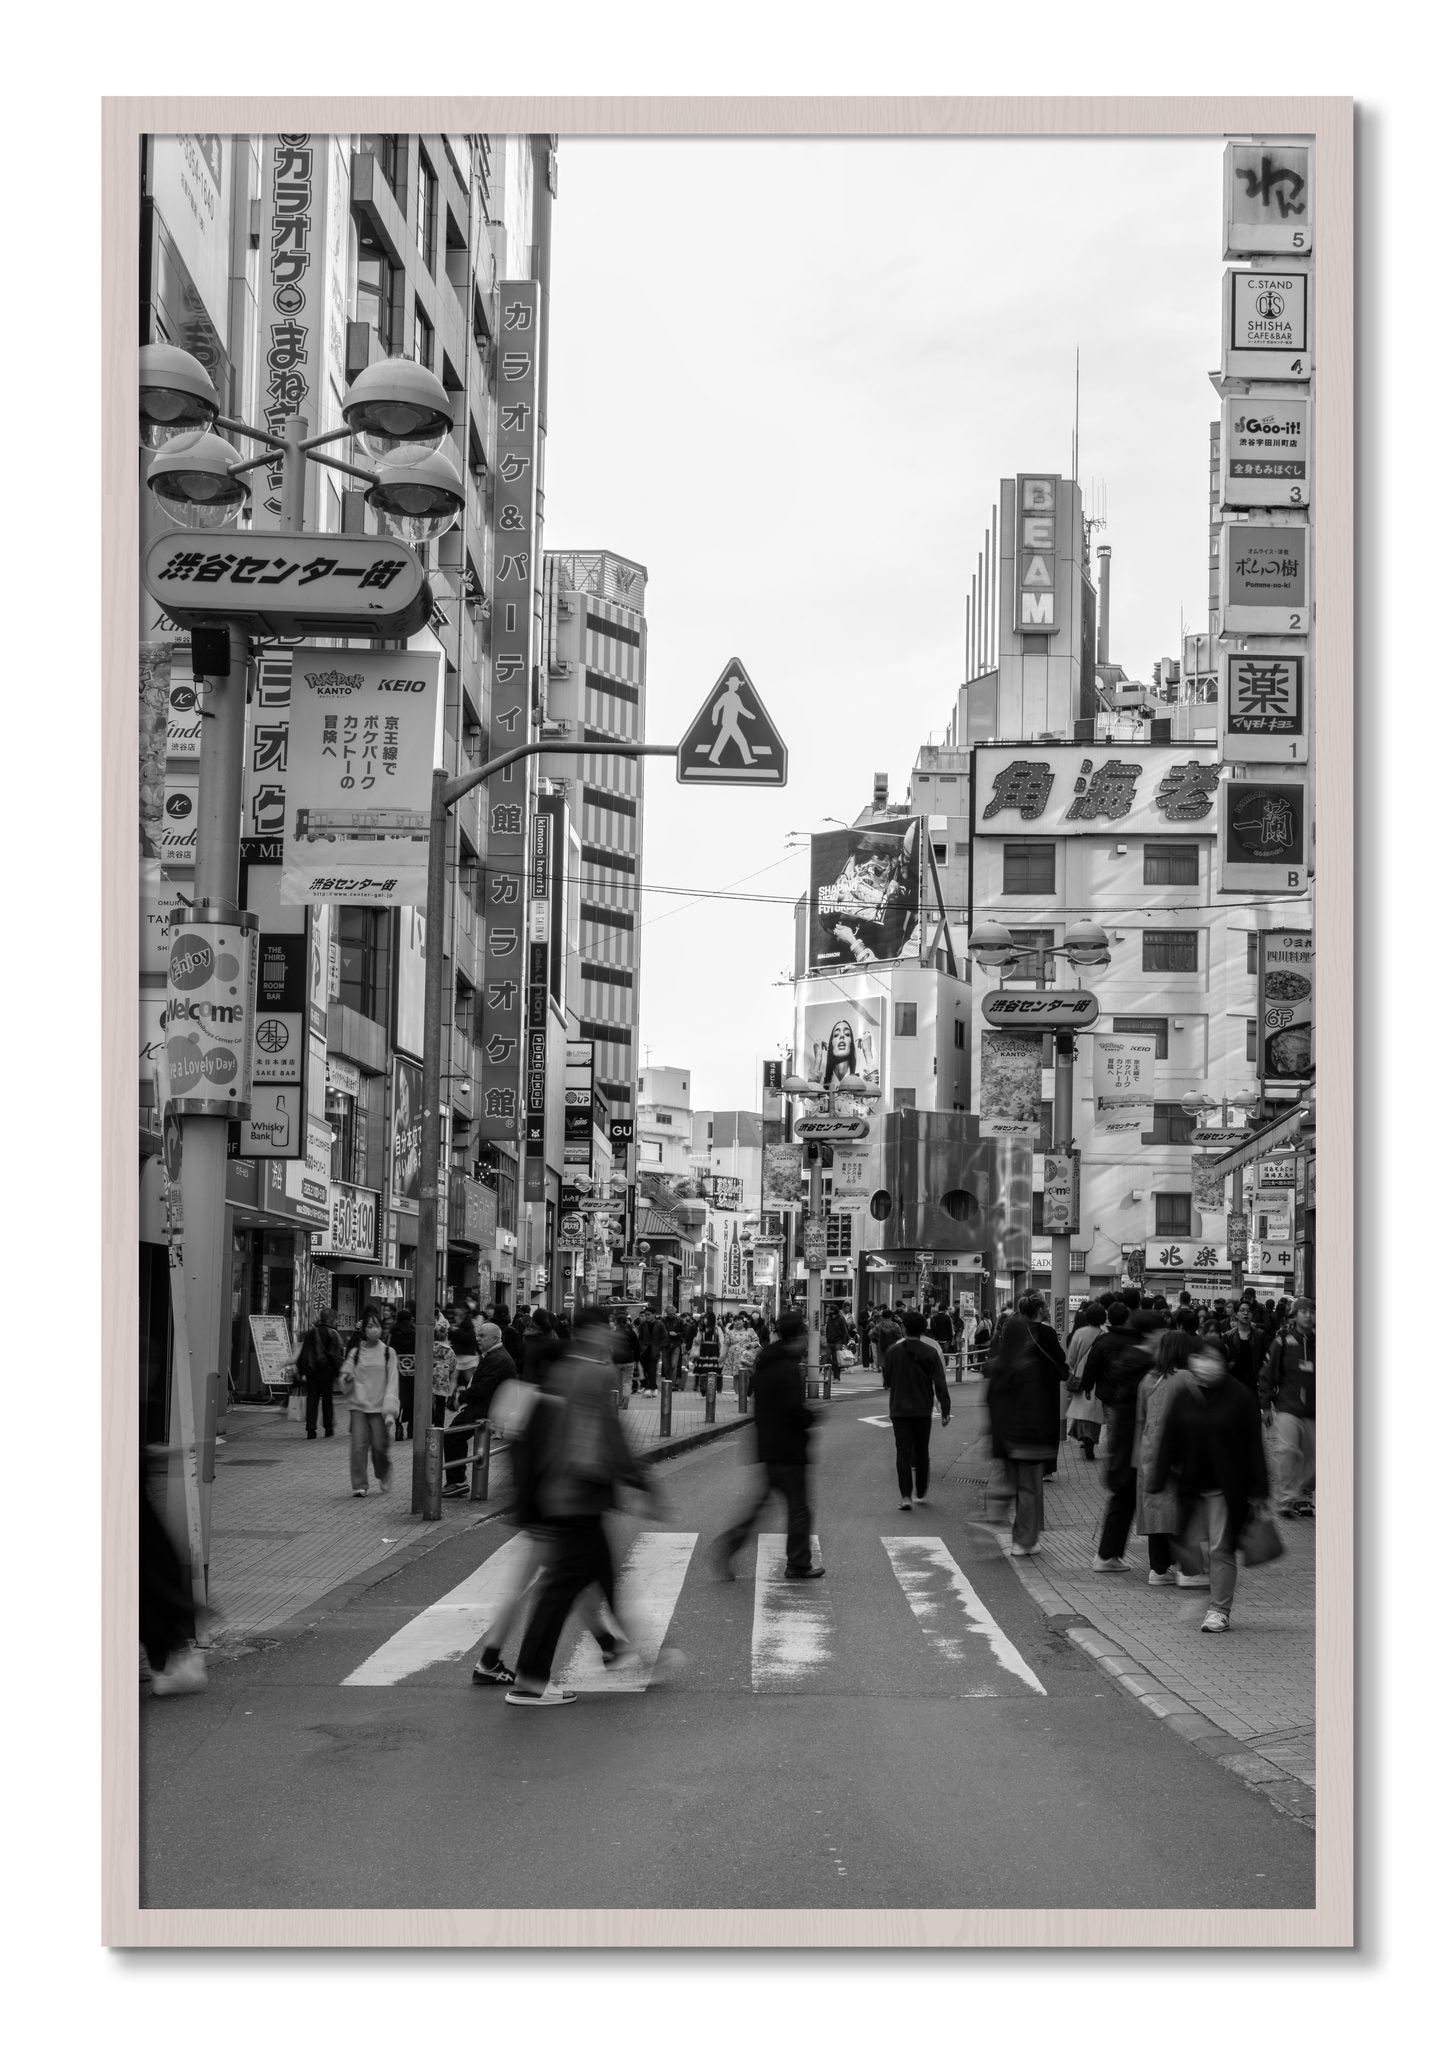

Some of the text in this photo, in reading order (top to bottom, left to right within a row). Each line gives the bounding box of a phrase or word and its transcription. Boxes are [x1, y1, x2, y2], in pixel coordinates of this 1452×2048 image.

[270, 146, 313, 285] カラオケ
[1292, 232, 1304, 248] 5
[1247, 280, 1293, 290] C.STAND
[1247, 320, 1292, 331] SHISHA
[1247, 331, 1292, 340] CAFE&BAR
[1291, 358, 1304, 375] 4
[1246, 418, 1301, 435] Goo-it!
[1234, 463, 1302, 475] 全身もみほぐし
[1290, 486, 1302, 503] 3
[1022, 479, 1055, 624] BEAM
[157, 551, 408, 590] 渋谷センター街
[1235, 557, 1299, 577] ポムの樹
[1289, 613, 1301, 629] 2
[317, 687, 352, 695] KANTO
[377, 679, 426, 693] KEIO
[1238, 662, 1289, 714] 薬
[1232, 717, 1295, 731] マツモトキヨシ
[322, 715, 338, 758] 冒険へ
[171, 743, 196, 751] 渋谷店
[340, 715, 358, 790] カントーの
[382, 716, 399, 775] 京王線で
[1288, 742, 1297, 758] 1
[983, 759, 1221, 820] 角海老
[1233, 798, 1293, 847] 一蘭
[537, 819, 546, 854] kimono
[166, 850, 192, 859] 渋谷店
[309, 878, 398, 891] 渋谷センター街
[1287, 871, 1299, 888] B
[268, 946, 282, 954] THE
[170, 948, 211, 982] Enjoy
[263, 982, 285, 990] ROOM
[166, 997, 244, 1023] Welcome
[989, 999, 1093, 1013] 渋谷センター街
[1265, 1008, 1294, 1028] 6F
[183, 1056, 214, 1077] Lovely
[216, 1057, 235, 1071] Day!
[251, 1122, 285, 1133] Whisky
[612, 1126, 632, 1136] GU
[797, 1122, 860, 1132] 渋谷センター街
[250, 1132, 271, 1140] Bank
[1194, 1132, 1252, 1141] 渋谷センター街
[1160, 1245, 1219, 1266] 兆楽
[731, 1243, 739, 1287] BEER
[728, 1285, 741, 1295] HALL
